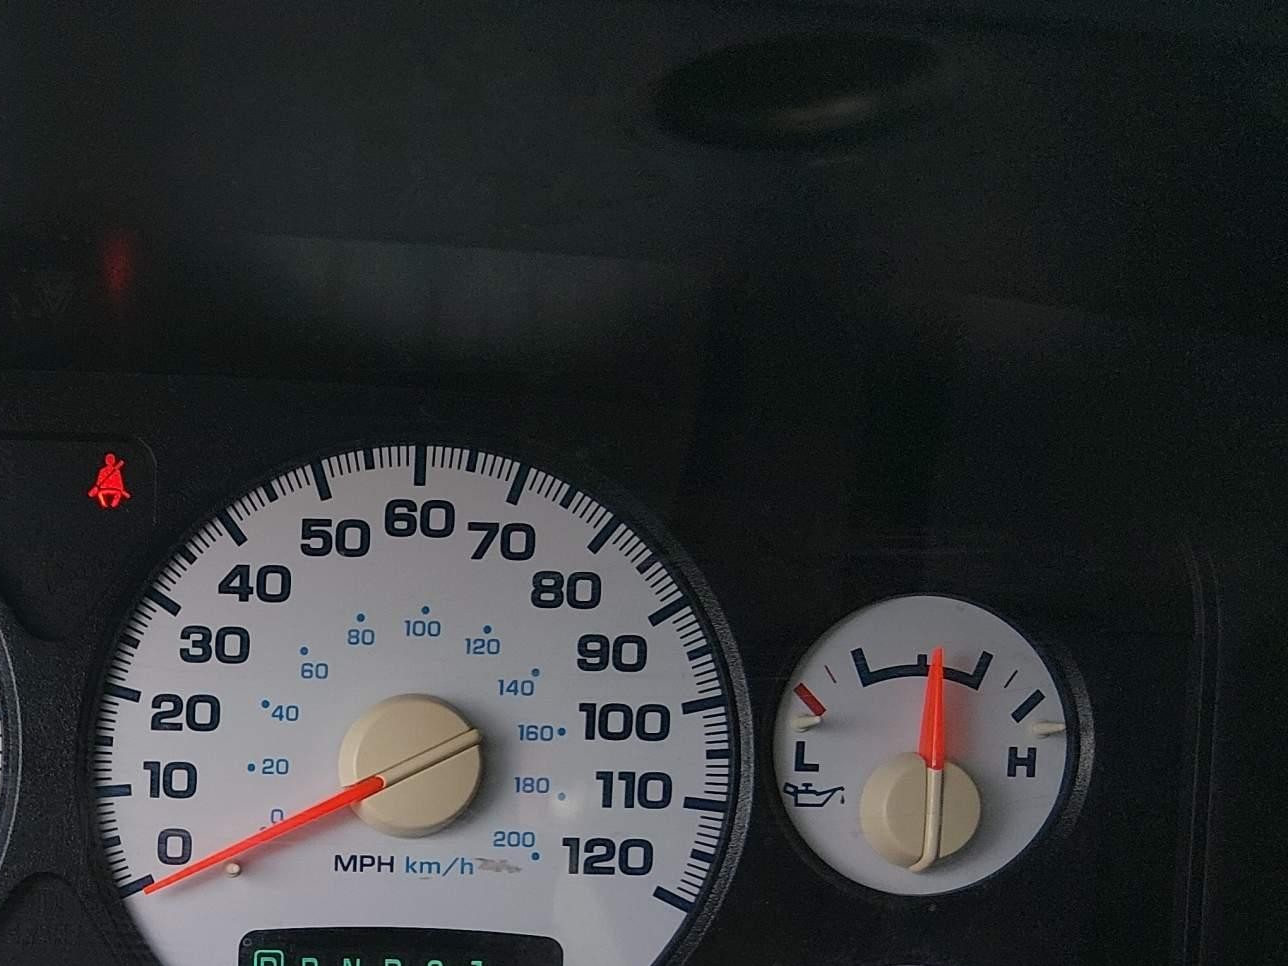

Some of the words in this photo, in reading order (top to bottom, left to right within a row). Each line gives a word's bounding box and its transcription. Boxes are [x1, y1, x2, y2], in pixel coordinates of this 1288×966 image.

[385, 499, 455, 538] 60
[301, 519, 370, 557] 50
[468, 522, 535, 561] 70
[218, 565, 291, 602] 40
[531, 571, 601, 609] 80
[348, 629, 374, 645] 80
[405, 620, 440, 636] 100
[180, 626, 250, 664] 30
[465, 638, 500, 654] 120
[577, 634, 647, 672] 90
[301, 663, 328, 679] 60
[498, 680, 534, 696] 140
[151, 694, 220, 731] 20
[272, 705, 298, 721] 40
[579, 703, 670, 741] 100
[518, 725, 553, 741] 160
[262, 759, 288, 774] 20
[795, 741, 819, 772] L
[1007, 747, 1036, 777] H
[143, 761, 197, 798] 10
[514, 777, 549, 793] 180
[596, 771, 672, 809] 110
[158, 829, 192, 865] 0
[494, 831, 535, 847] 200
[335, 855, 394, 872] MPH
[406, 856, 473, 876] km/h
[563, 838, 653, 875] 120
